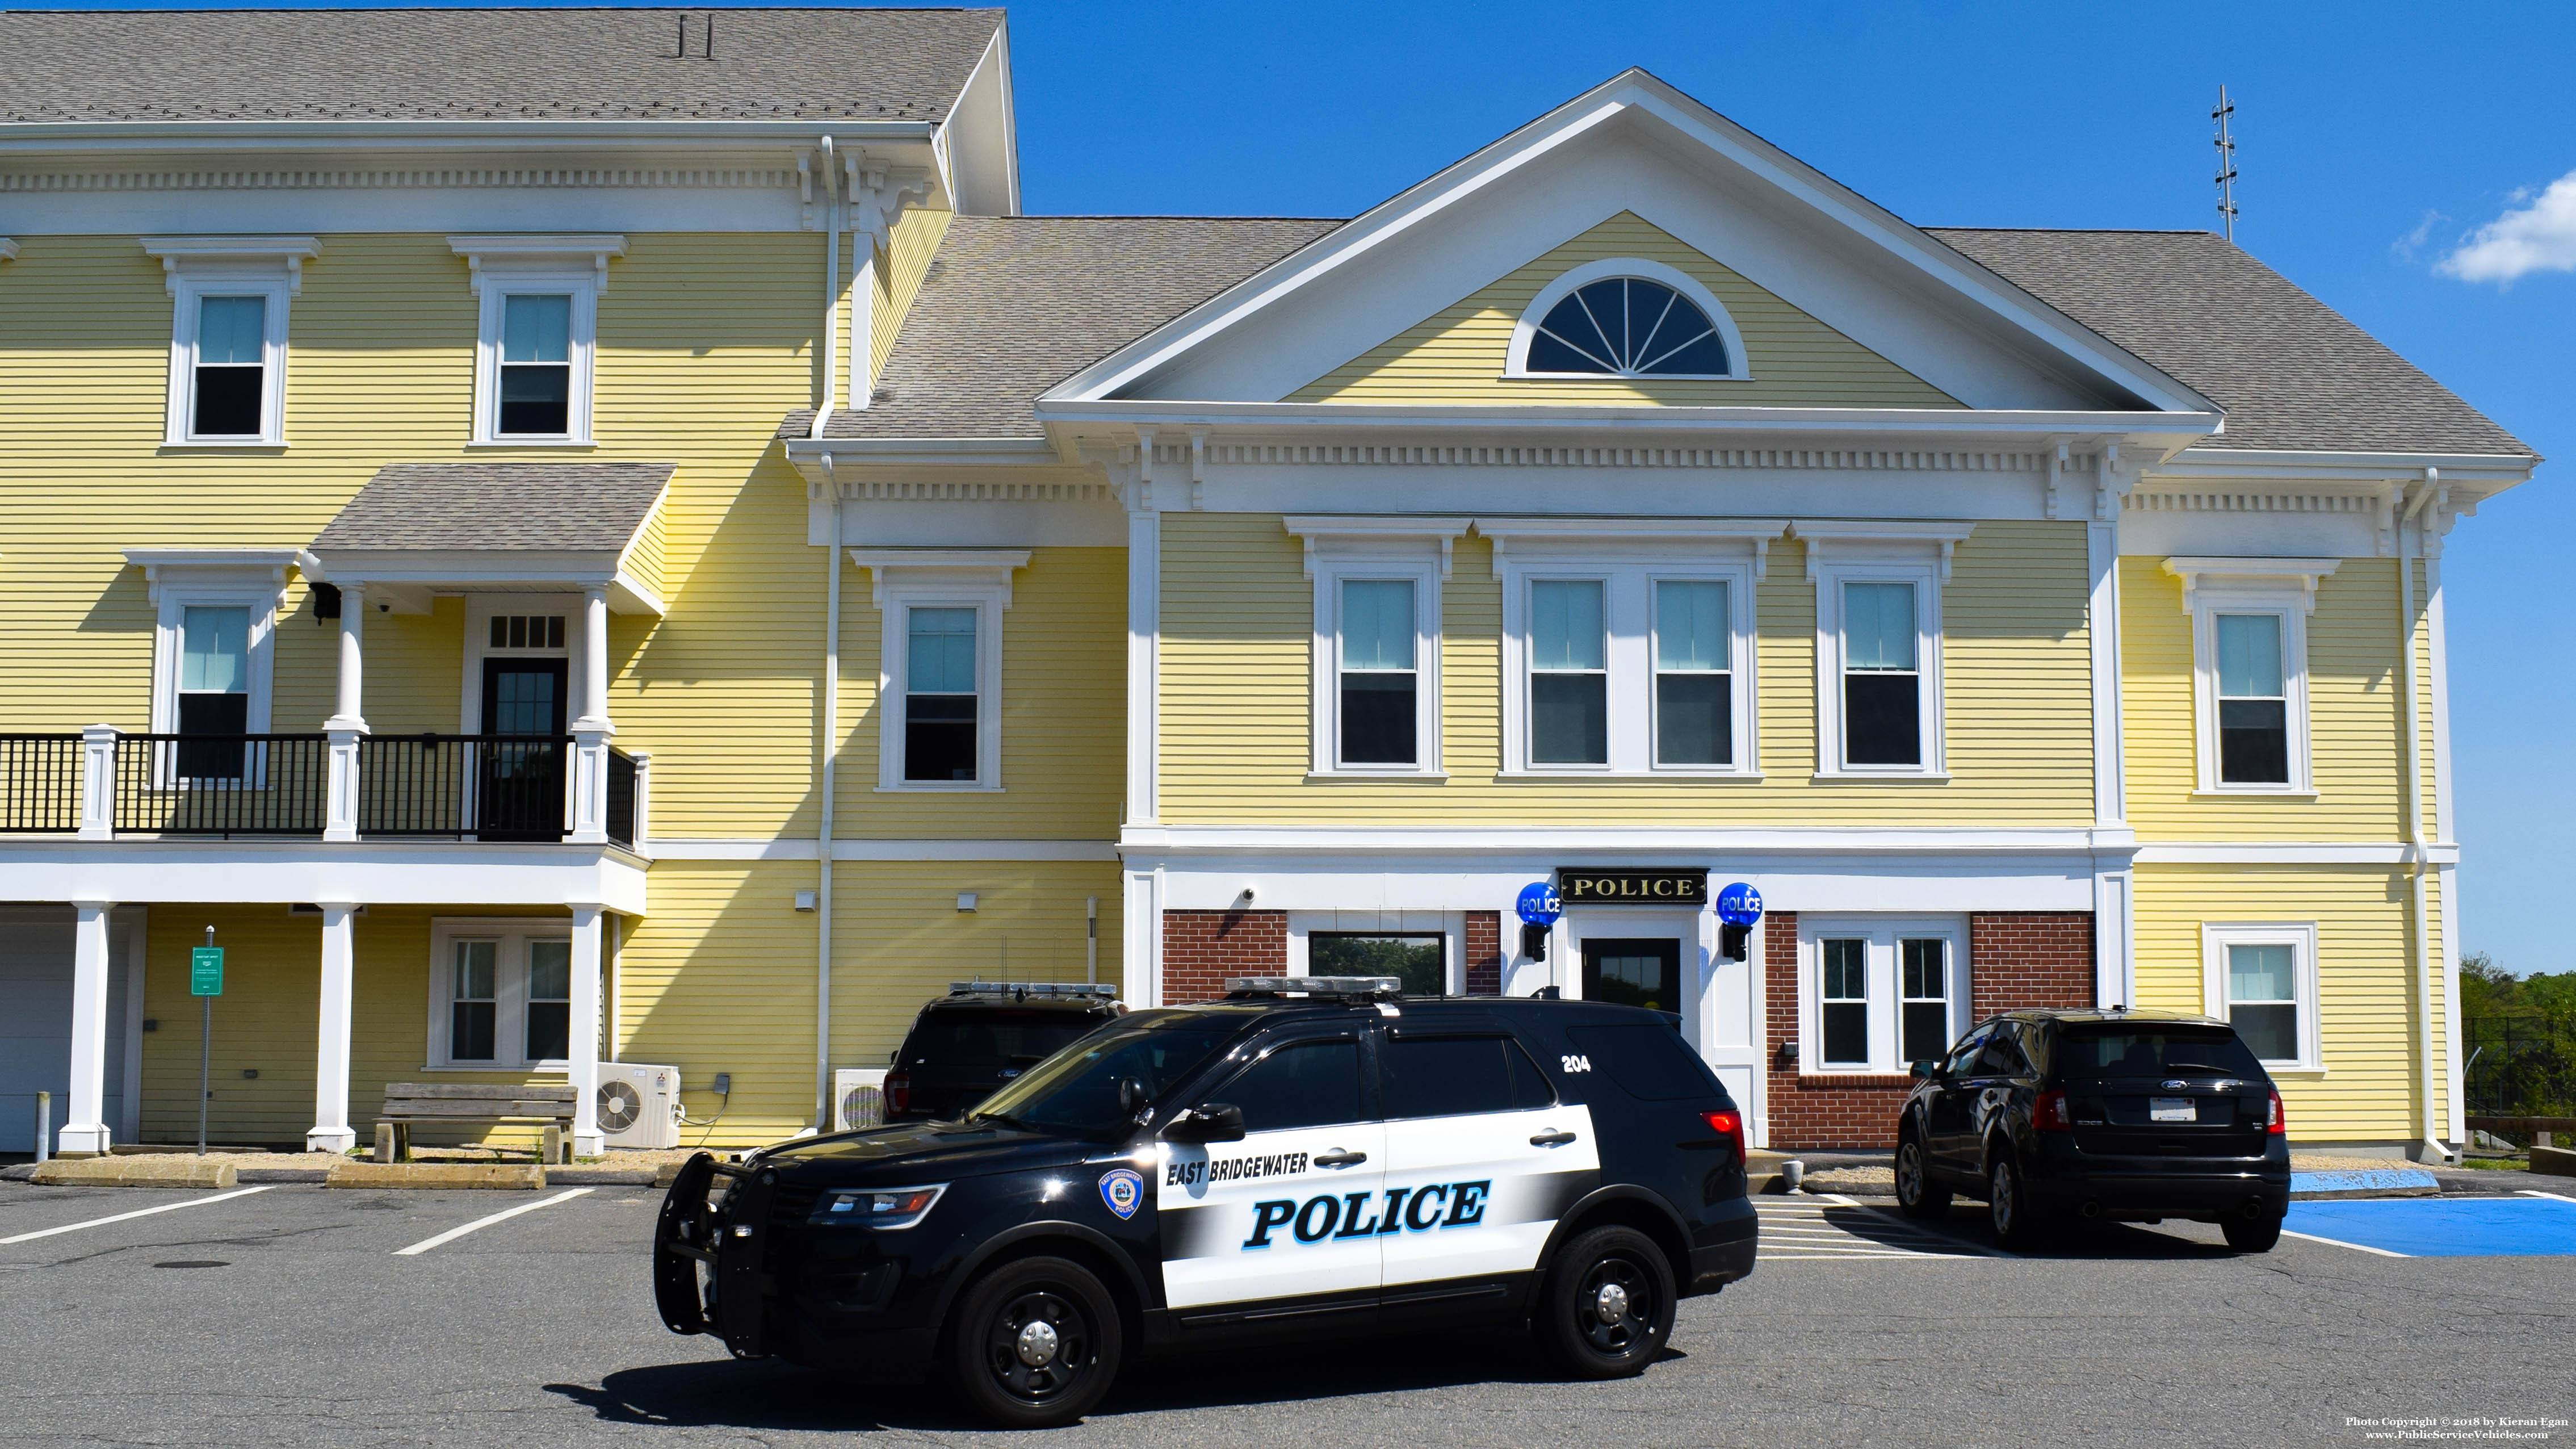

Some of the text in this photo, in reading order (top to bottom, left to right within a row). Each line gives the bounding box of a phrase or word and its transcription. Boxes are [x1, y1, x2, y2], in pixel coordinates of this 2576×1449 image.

[1574, 879, 1694, 896] POLICE
[1522, 898, 1560, 912] POLICE
[1722, 897, 1760, 912] POLICE
[1562, 1055, 1591, 1073] 204
[1166, 1152, 1308, 1187] EAST BRIDGEWATER
[1101, 1172, 1140, 1186] EAST BRIDGEWATER
[1241, 1178, 1493, 1251] POLICE
